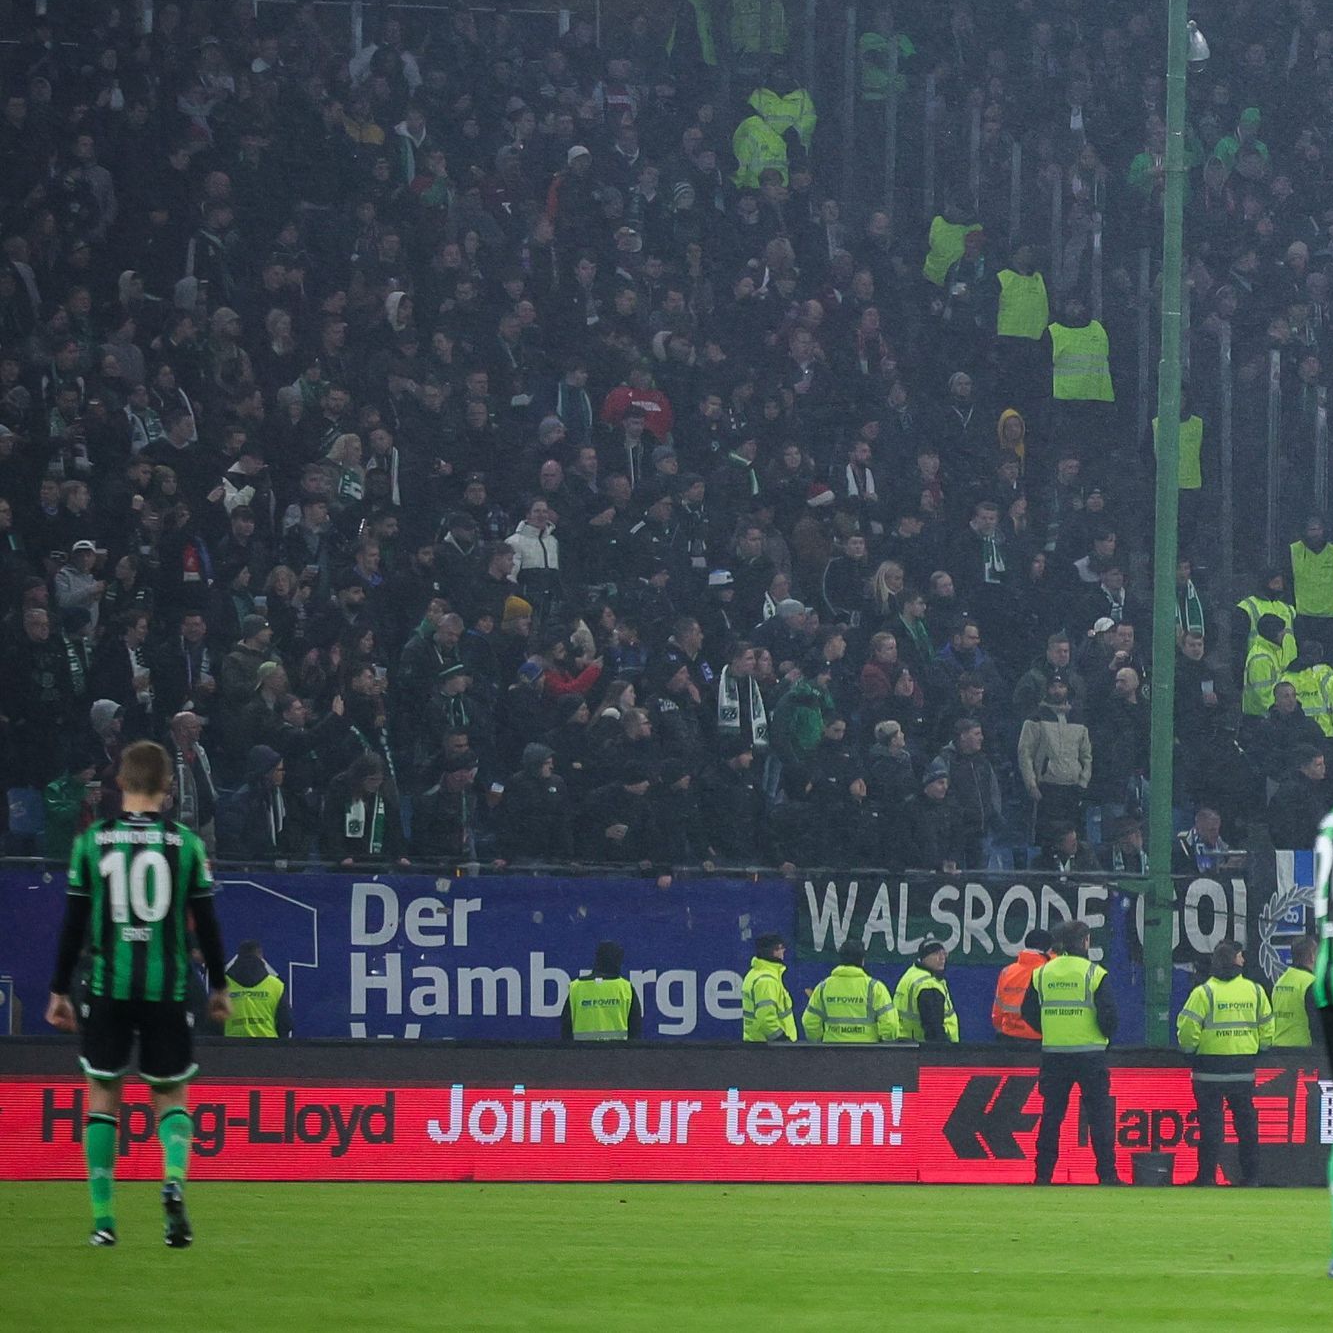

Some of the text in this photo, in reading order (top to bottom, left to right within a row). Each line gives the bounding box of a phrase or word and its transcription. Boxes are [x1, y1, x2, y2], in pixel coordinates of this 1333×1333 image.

[99, 850, 172, 924] 10
[350, 882, 483, 947] Der
[804, 879, 1107, 961] WALSRODE
[350, 952, 743, 1035] Hambrge
[42, 1084, 904, 1158] Hpg-Lloyd Join our team!
